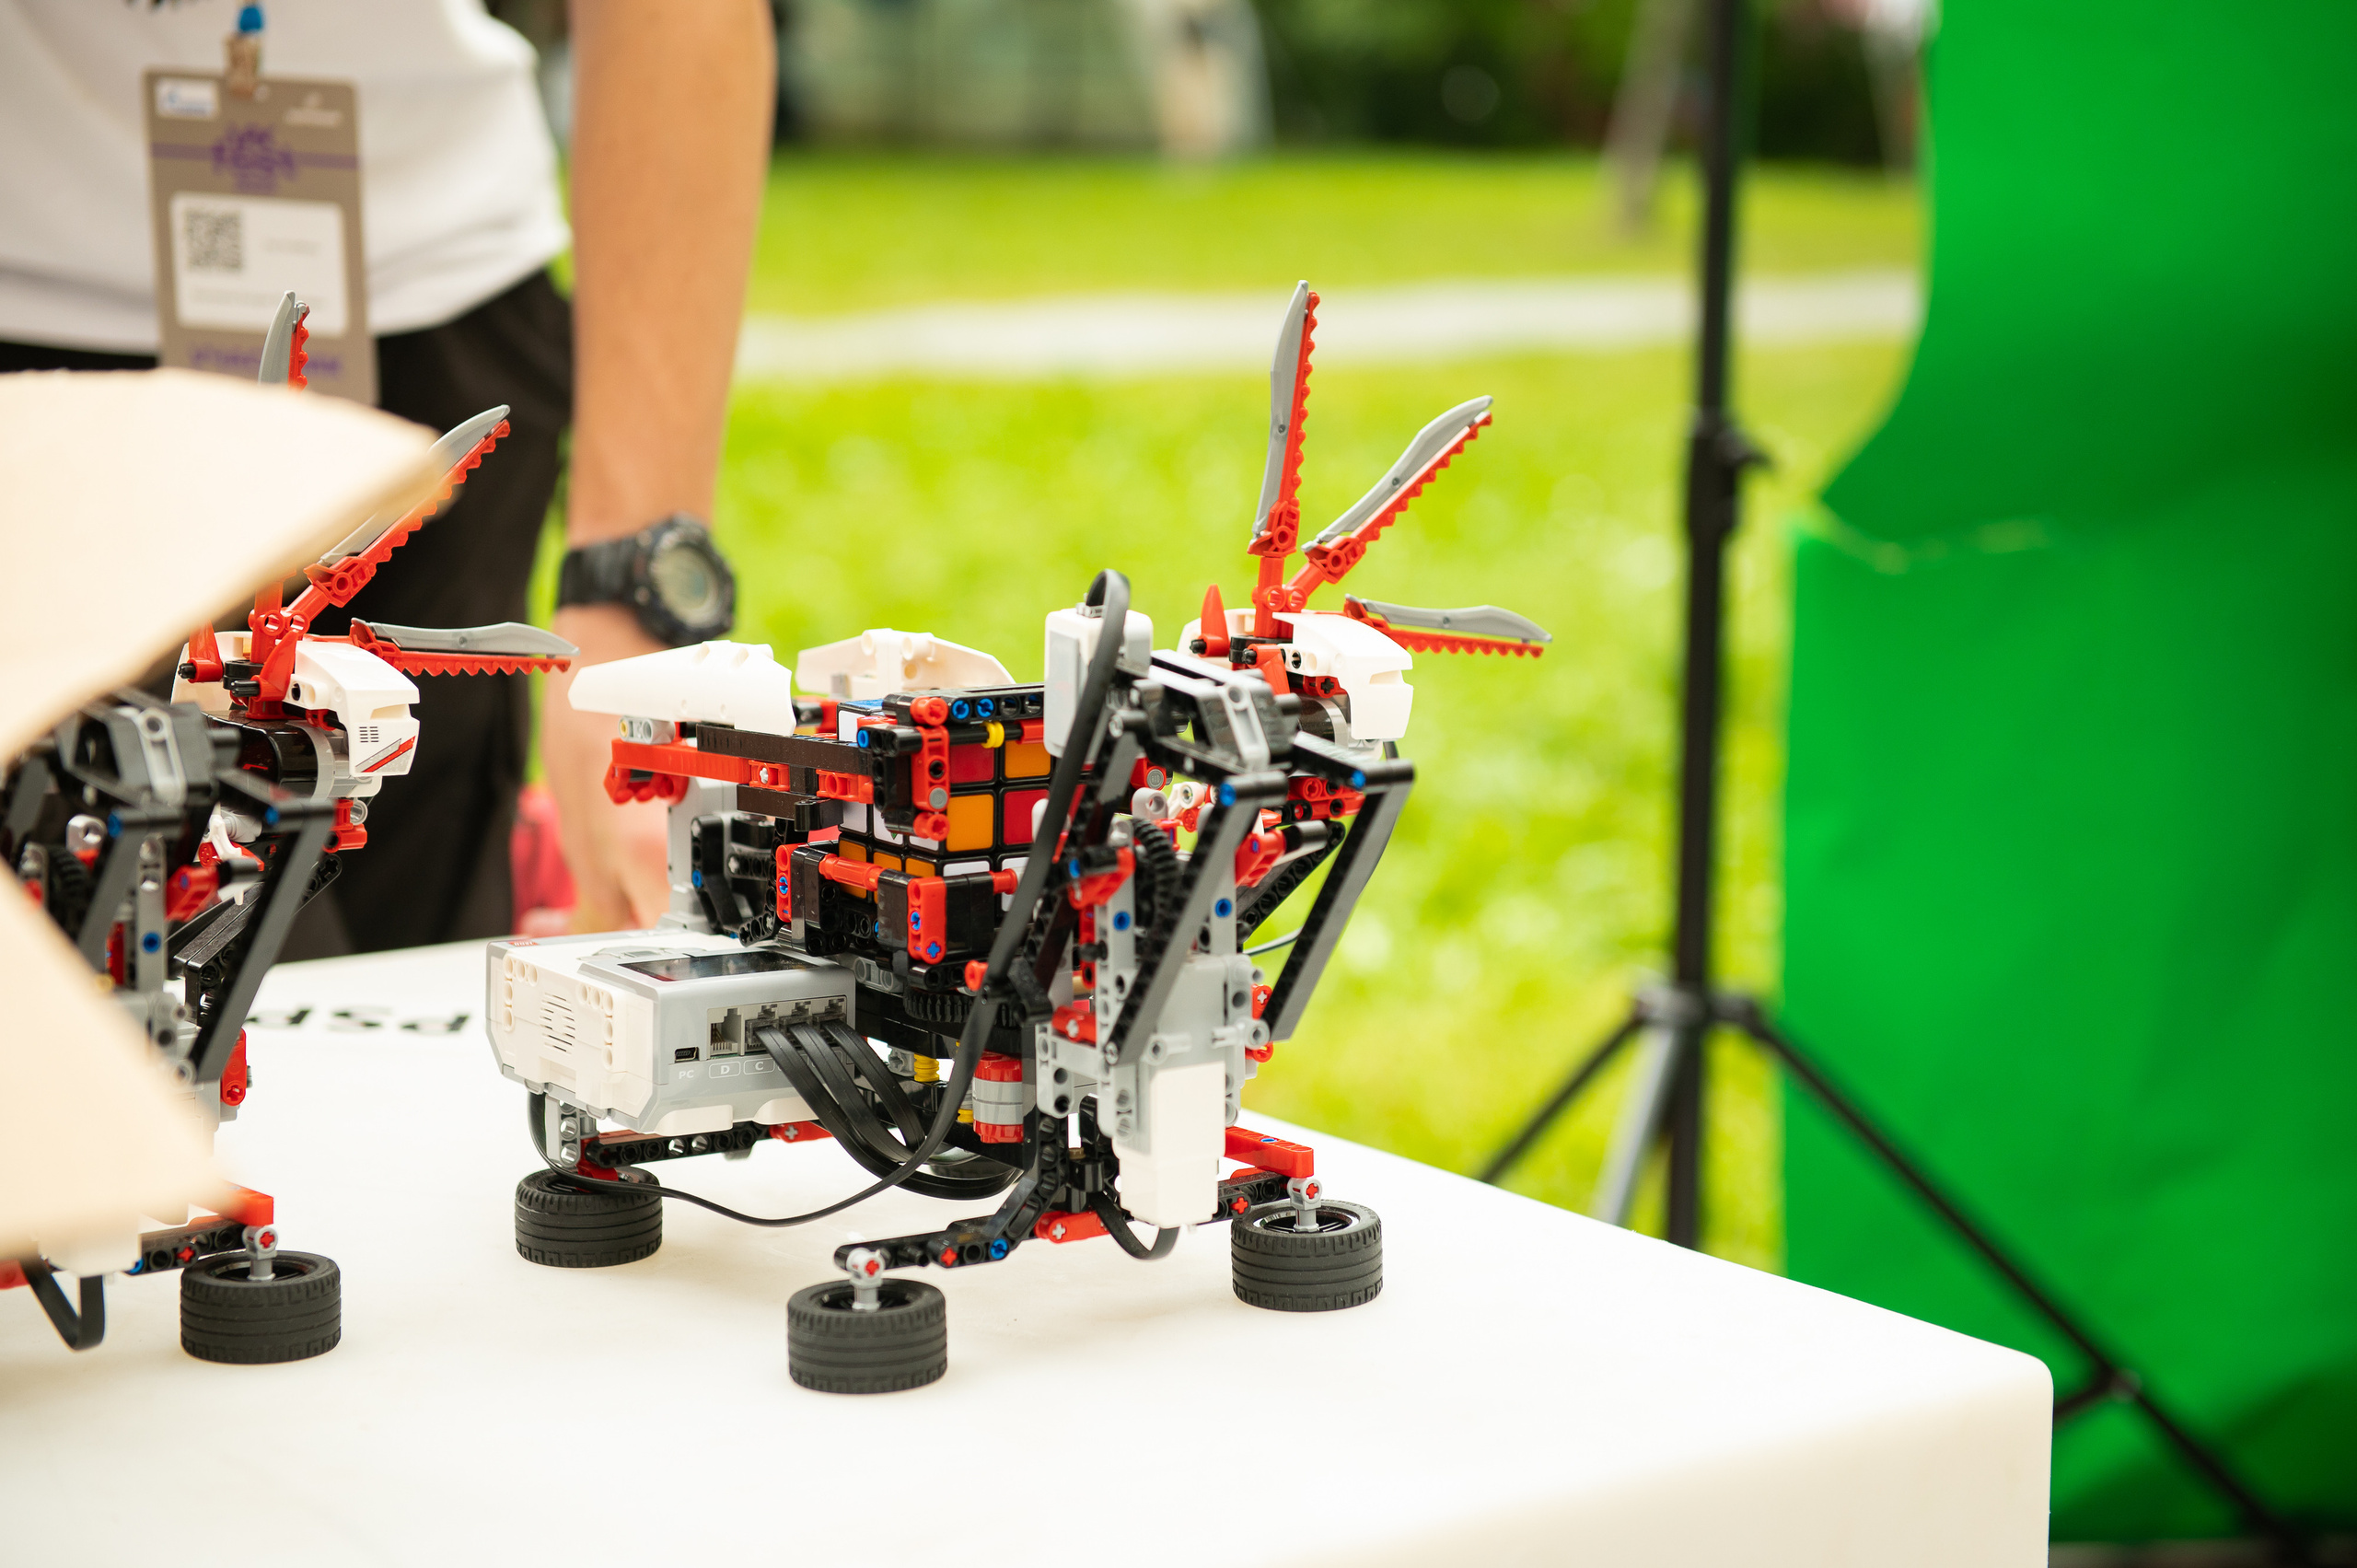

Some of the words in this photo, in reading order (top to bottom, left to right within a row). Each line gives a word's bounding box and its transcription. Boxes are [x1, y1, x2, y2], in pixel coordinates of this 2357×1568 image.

[721, 1065, 730, 1074] D
[755, 1062, 764, 1071] C
[679, 1070, 694, 1080] PC
